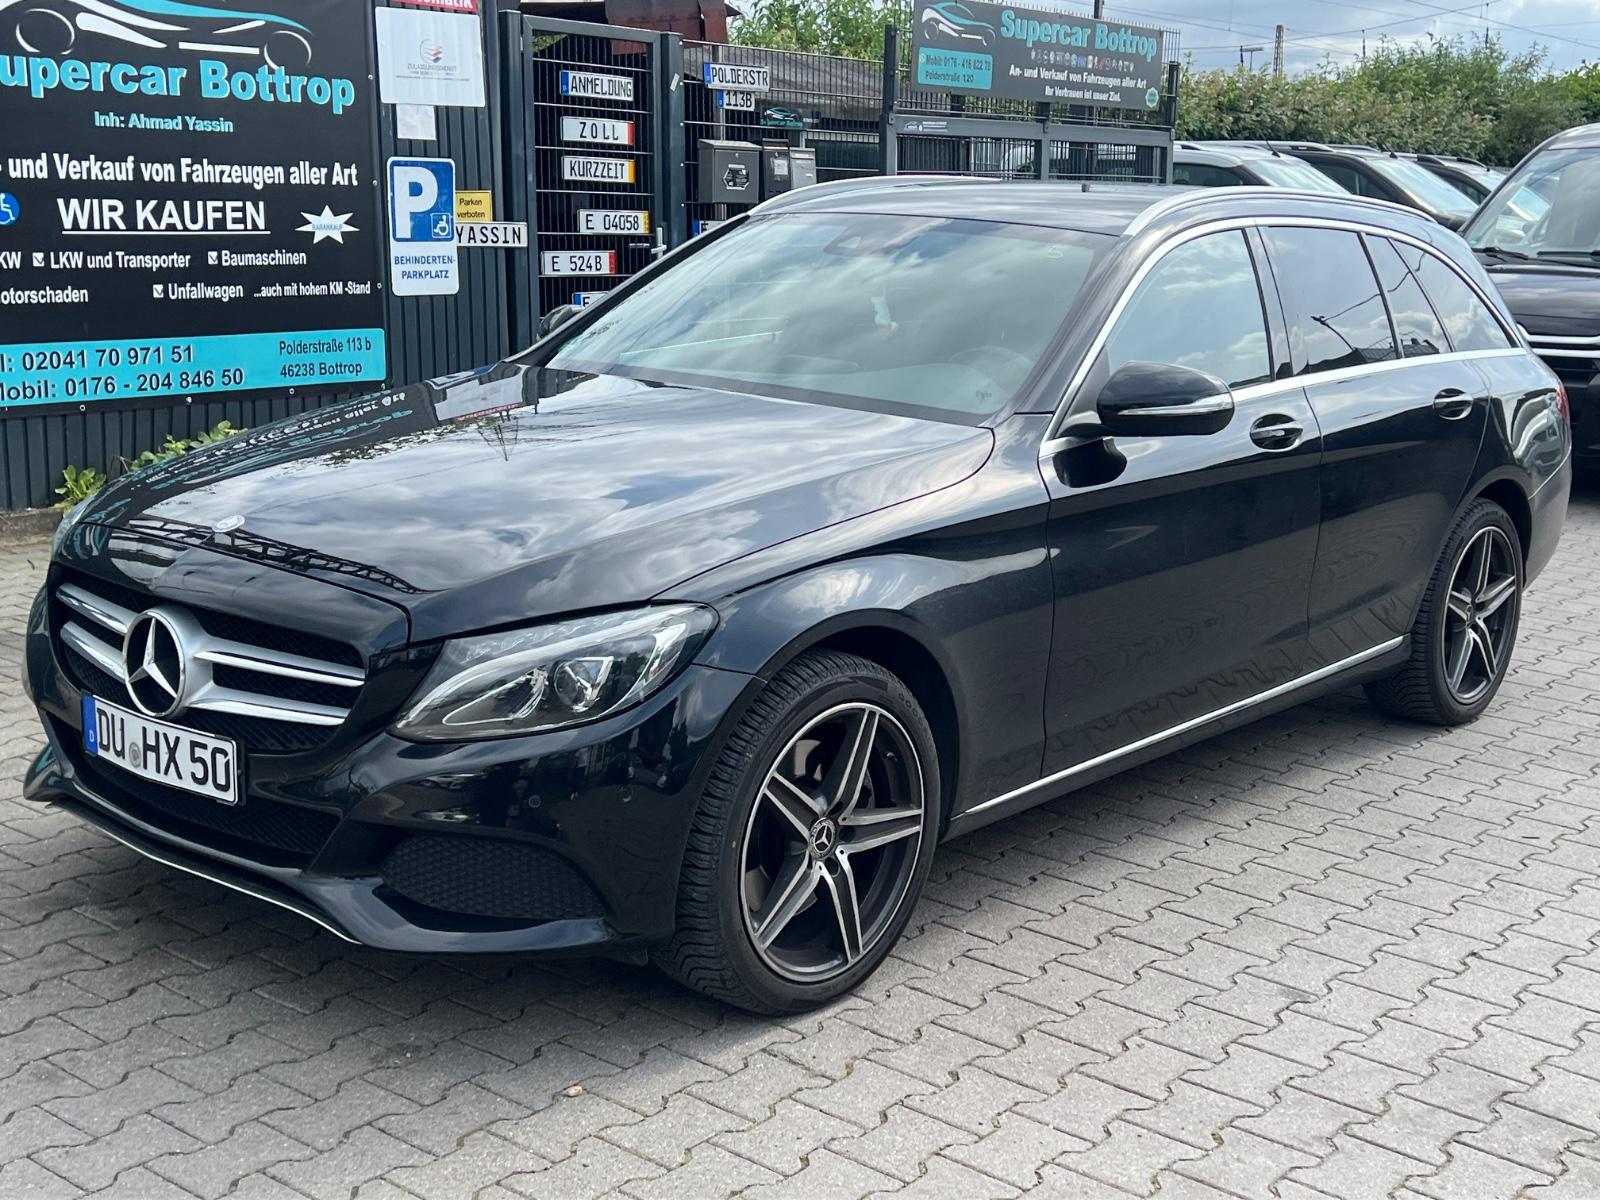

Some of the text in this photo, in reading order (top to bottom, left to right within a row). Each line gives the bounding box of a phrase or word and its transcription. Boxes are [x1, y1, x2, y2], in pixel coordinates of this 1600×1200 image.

[1000, 9, 1157, 61] Supercar Bottrop
[571, 75, 632, 97] ANMELDUNG
[711, 67, 768, 86] POLDERSTR
[1009, 64, 1147, 89] An- und Verkauf von Fahrzeugen aller Art
[200, 59, 355, 114] Bottrop
[1055, 87, 1083, 99] Vertrauen
[1084, 89, 1092, 99] ist
[1093, 91, 1108, 101] unser
[726, 90, 752, 108] 113B
[94, 111, 234, 133] Inh: Ahmad Yassin
[580, 121, 618, 141] ZOLL
[8, 153, 358, 190] und Verkauf von Fahrzeugen aller Art
[570, 160, 625, 179] KURZZEIT
[393, 166, 438, 239] P
[459, 198, 482, 206] Parken
[57, 198, 265, 231] WIR KAUFEN
[457, 210, 485, 218] verboten
[586, 214, 594, 230] E
[603, 214, 639, 231] 04058
[456, 226, 522, 244] YASSIN
[50, 251, 83, 269] LKW
[87, 252, 112, 268] und
[115, 251, 191, 272] Transporter
[221, 250, 307, 267] Baumaschinen
[394, 255, 456, 265] BEHINDERTEN-
[552, 256, 560, 272] E
[402, 270, 449, 279] PARKPLATZ
[0, 285, 89, 304] otorschaden
[168, 283, 244, 302] Unfallwagen
[253, 285, 282, 298] ...auch
[283, 283, 298, 296] mit
[299, 283, 328, 296] hohem
[329, 282, 343, 295] KM
[279, 338, 372, 356] Polderstraße 113 b
[22, 349, 87, 371] 02041
[96, 348, 120, 368] 70
[128, 346, 164, 366] 971
[171, 345, 193, 364] 51
[280, 361, 363, 378] 46238 Bottrop
[65, 376, 116, 396] 0176
[137, 371, 172, 392] 204
[179, 370, 214, 389] 846
[221, 368, 244, 386] 50
[97, 707, 125, 760] DU
[142, 726, 183, 780] HX
[190, 740, 231, 792] 50
